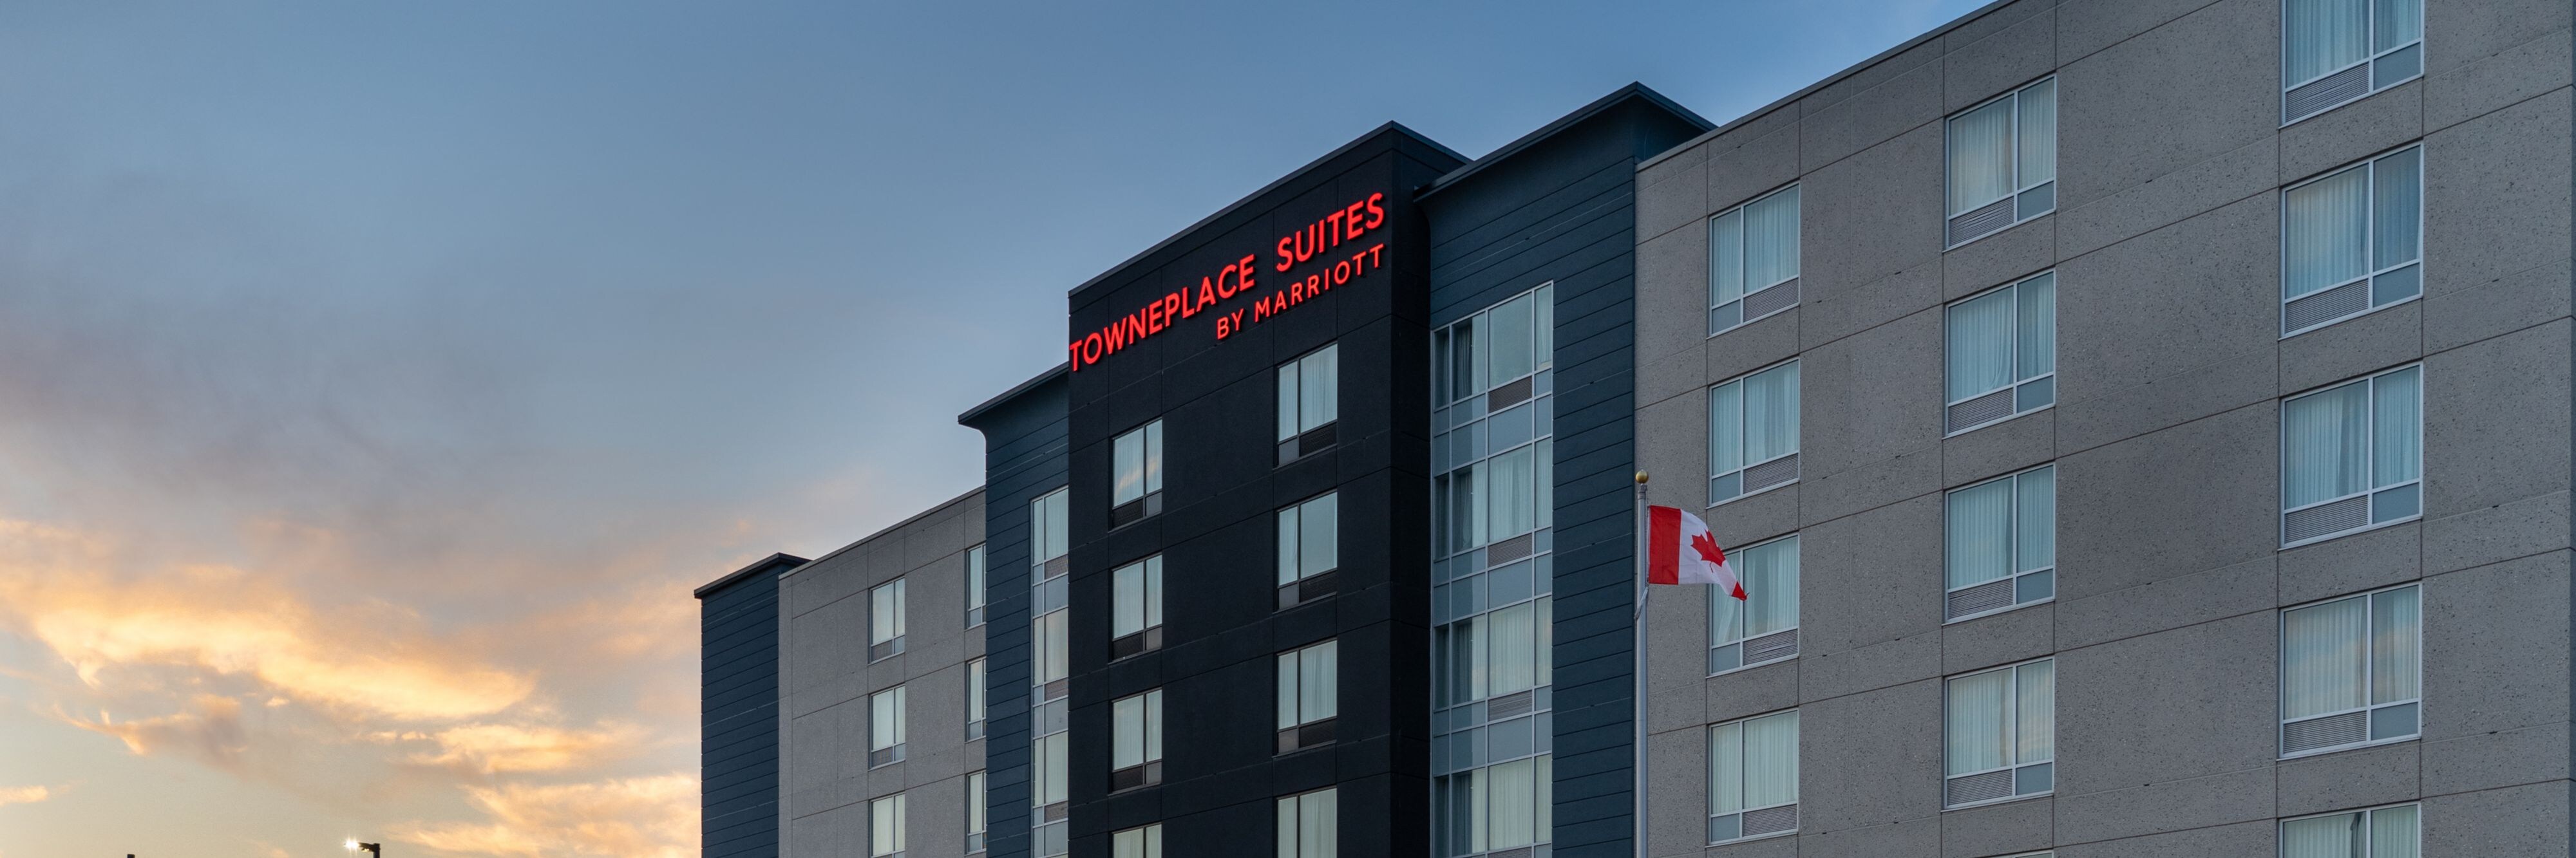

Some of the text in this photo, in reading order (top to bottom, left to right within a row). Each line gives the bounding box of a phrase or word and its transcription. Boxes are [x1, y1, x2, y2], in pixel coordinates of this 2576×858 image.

[1068, 192, 1385, 372] TOWNEPLACE SUITES
[1217, 243, 1385, 340] BY MARRIOTT
